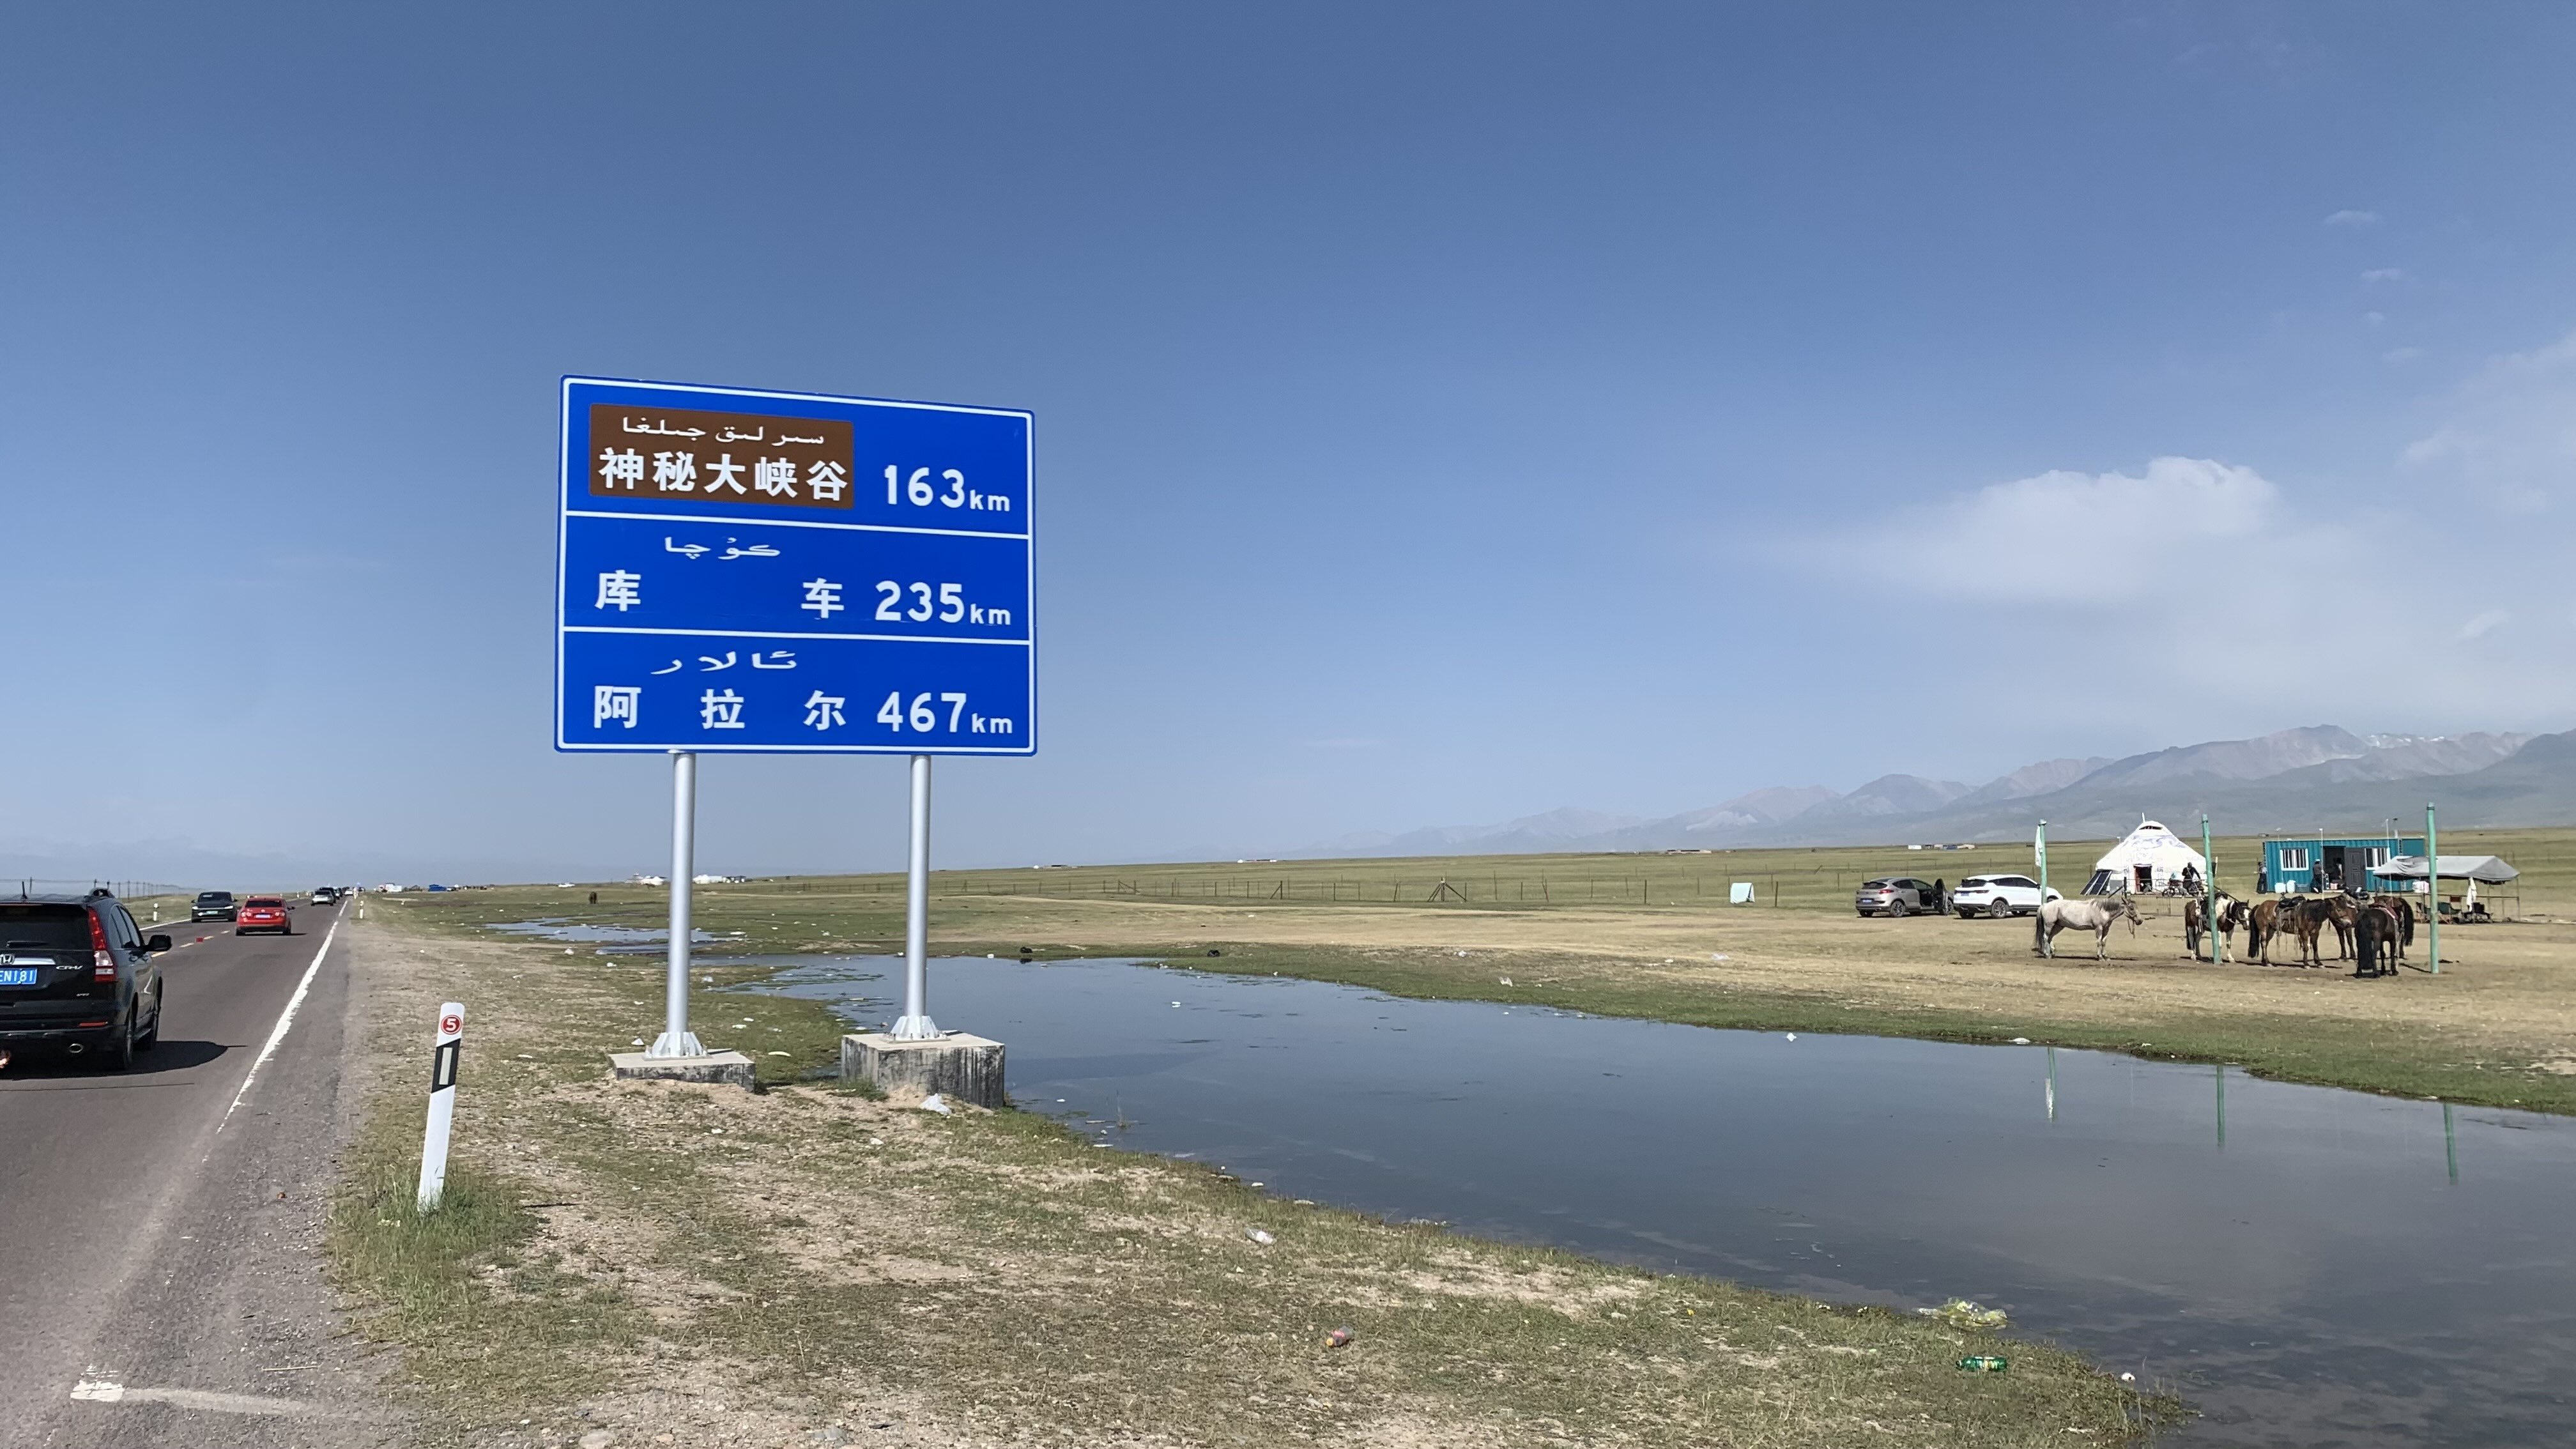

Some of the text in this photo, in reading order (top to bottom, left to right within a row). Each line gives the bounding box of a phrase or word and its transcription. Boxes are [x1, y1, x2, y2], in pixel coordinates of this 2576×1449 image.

[598, 447, 848, 502] 神秘大峡谷
[445, 1018, 457, 1031] 5
